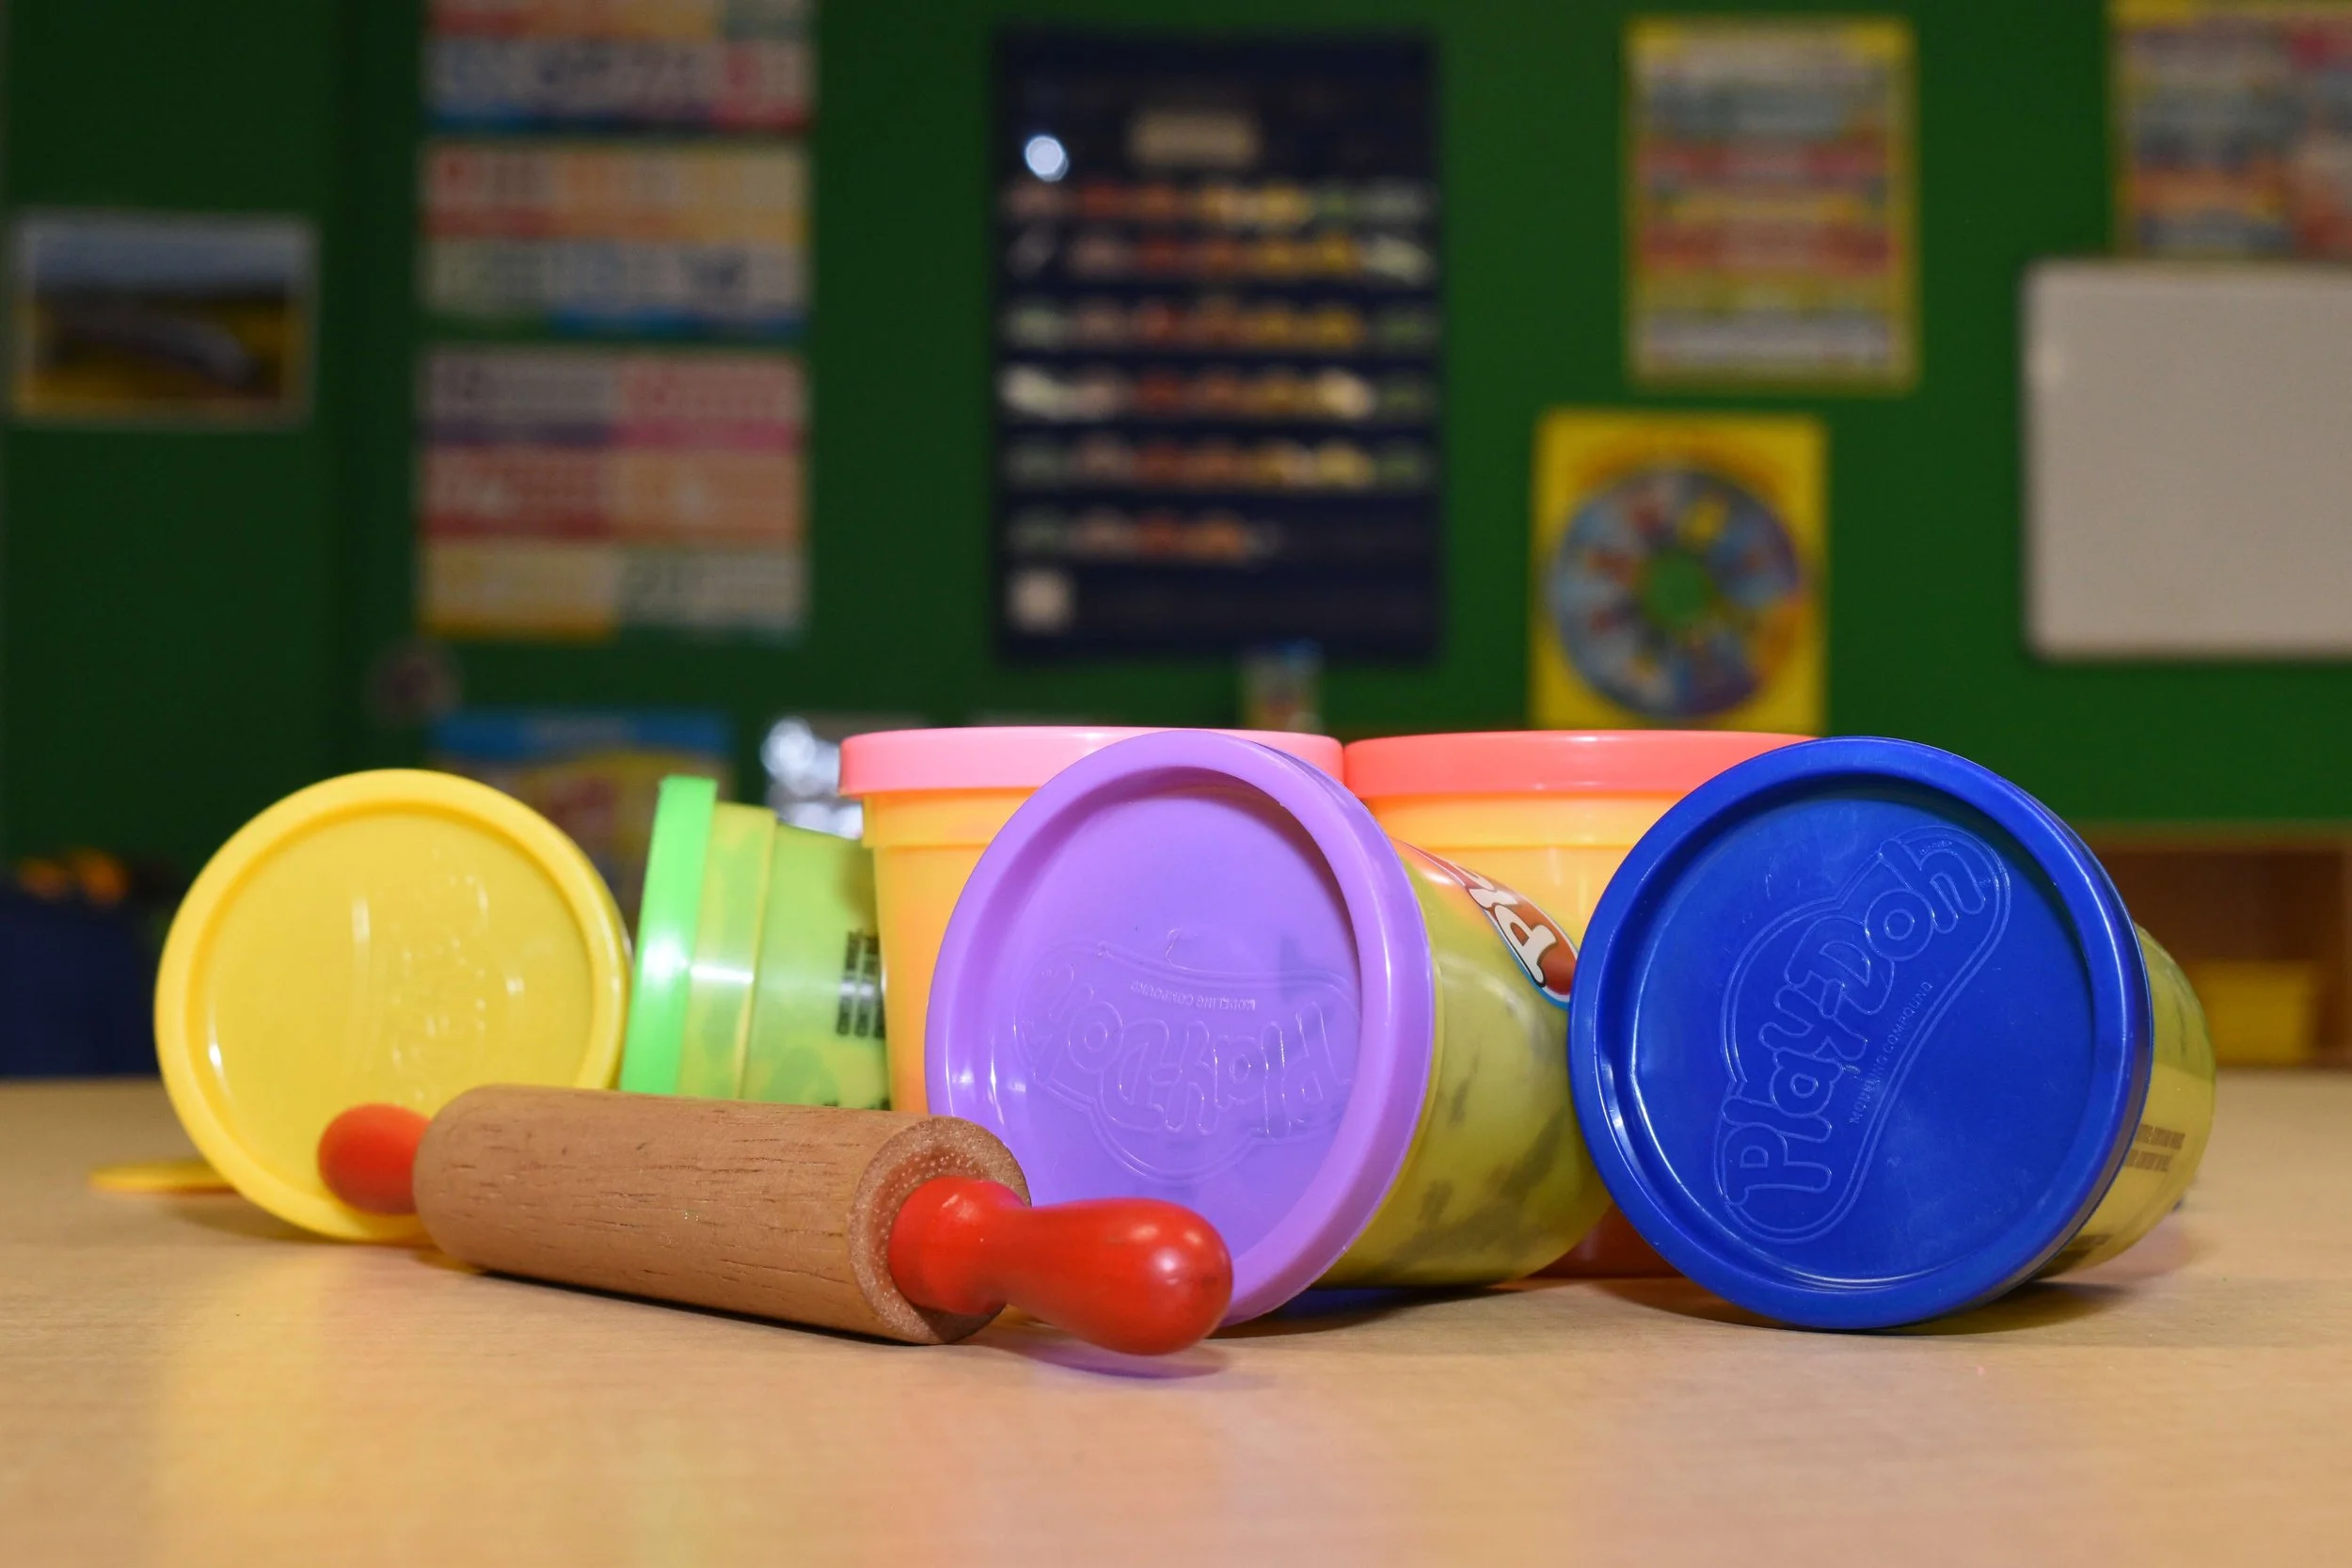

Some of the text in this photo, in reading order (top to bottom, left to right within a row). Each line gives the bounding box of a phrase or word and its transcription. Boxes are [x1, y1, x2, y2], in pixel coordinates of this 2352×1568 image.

[1020, 961, 1353, 1135] Play-Doh
[1722, 838, 1986, 1207] Play-Doh
[1882, 980, 1934, 1053] COMPOUND
